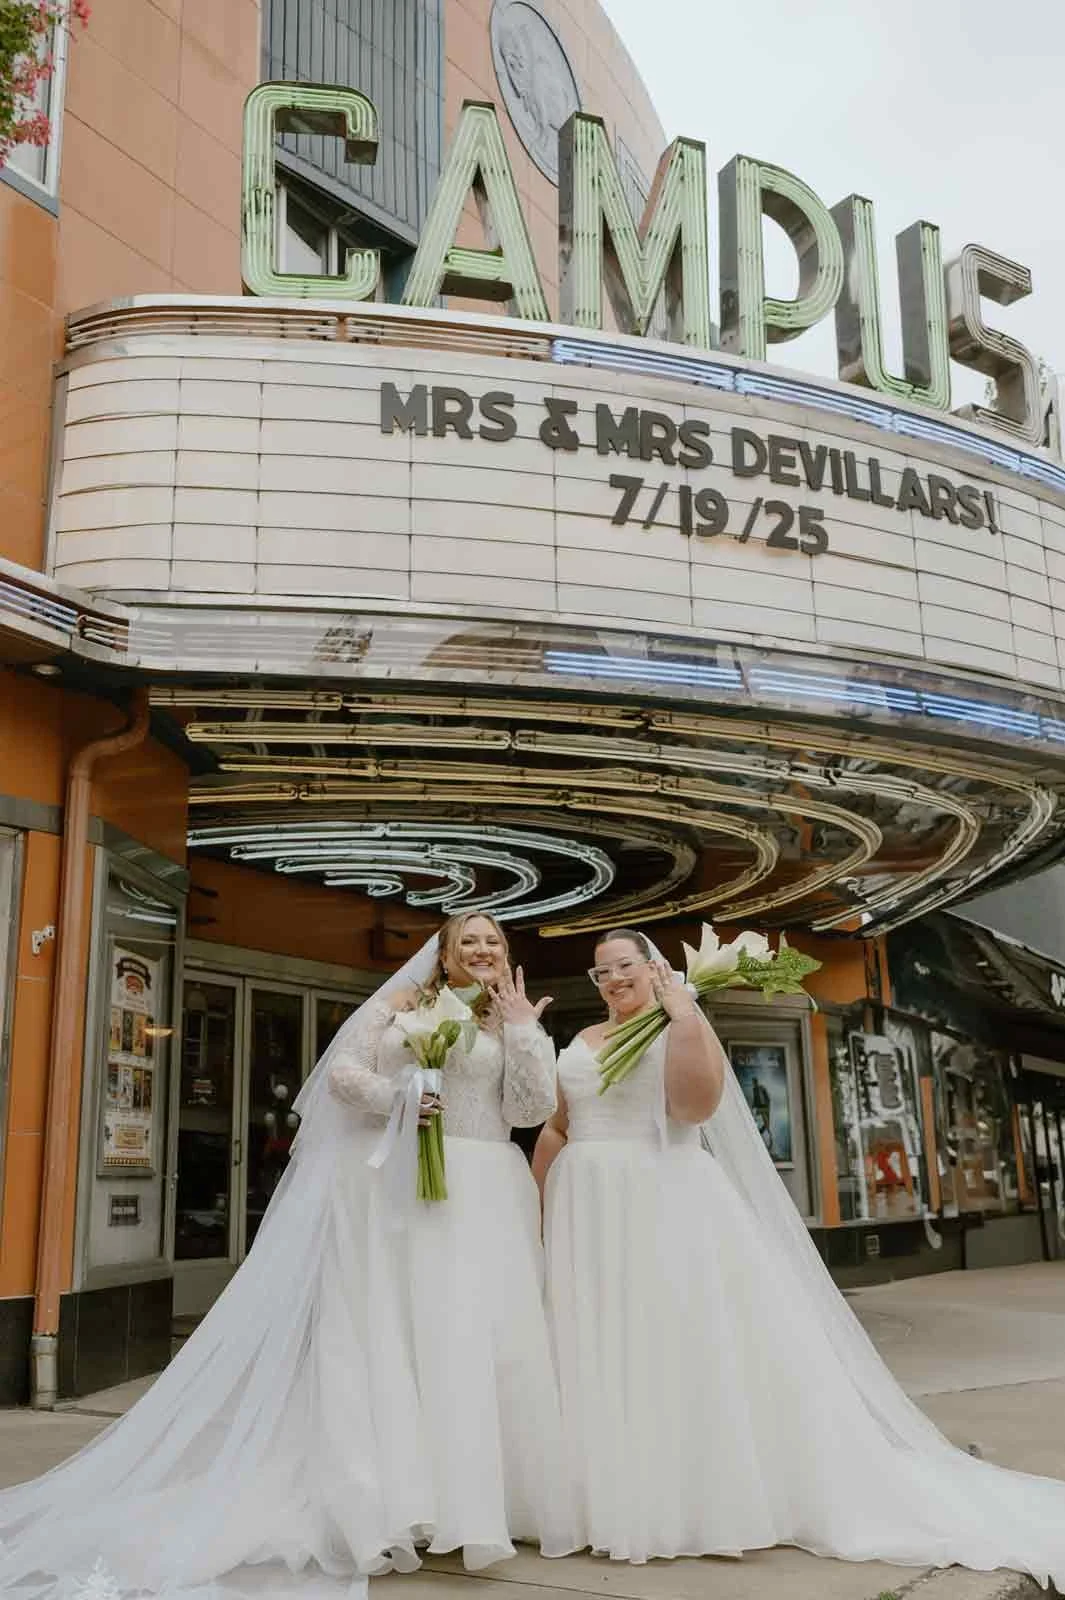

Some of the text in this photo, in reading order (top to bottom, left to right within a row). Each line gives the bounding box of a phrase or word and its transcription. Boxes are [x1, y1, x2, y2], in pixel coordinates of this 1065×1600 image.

[241, 80, 1041, 448] CAMPUS
[380, 381, 1000, 536] MRS & MRS DEVILLARS!
